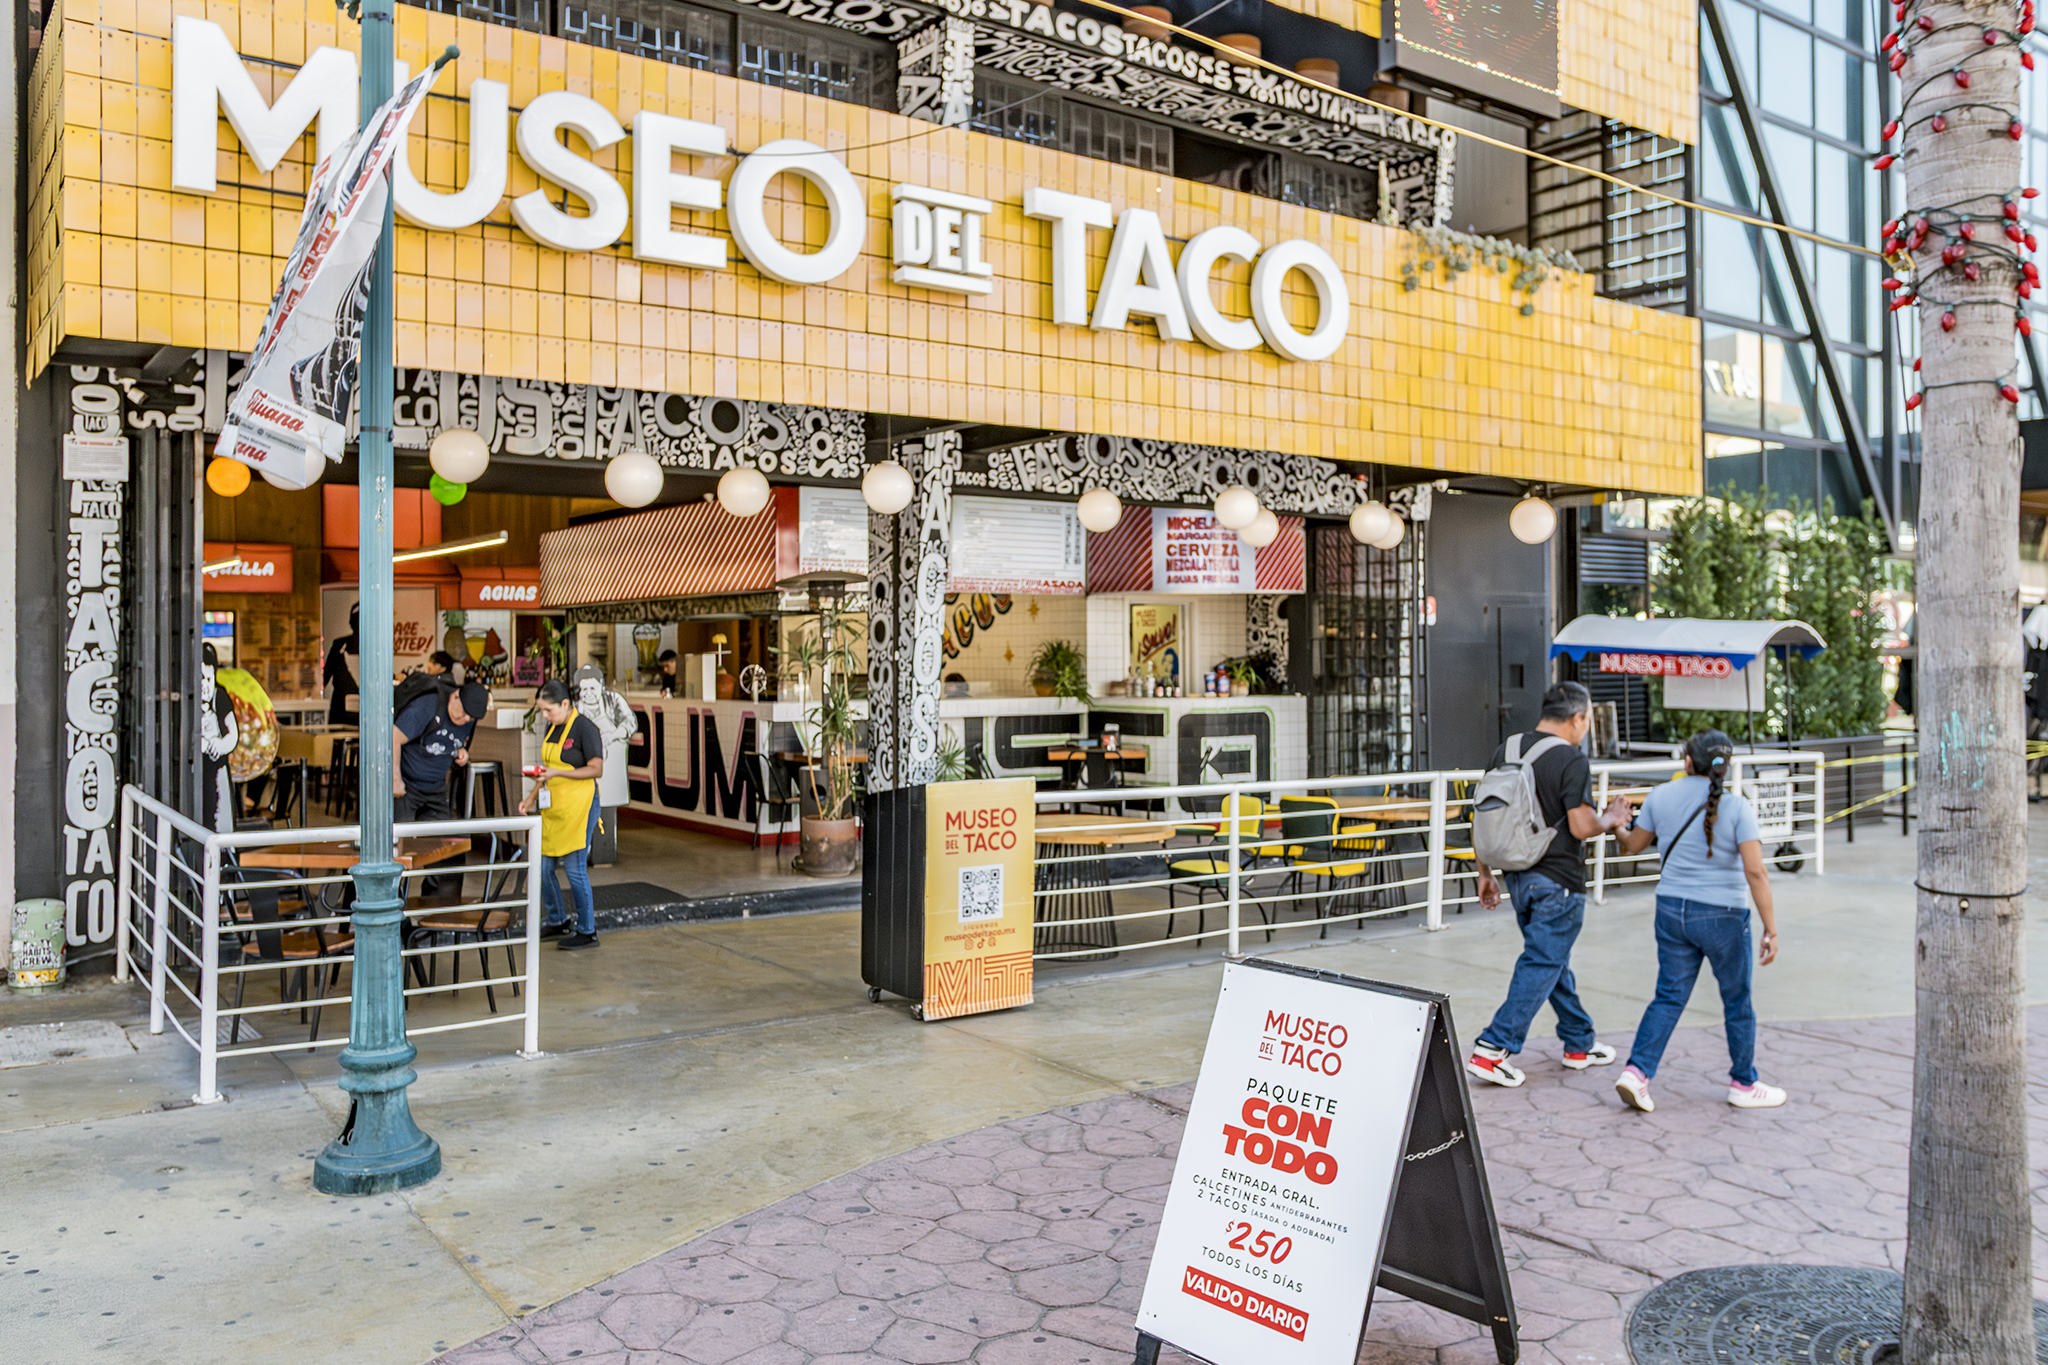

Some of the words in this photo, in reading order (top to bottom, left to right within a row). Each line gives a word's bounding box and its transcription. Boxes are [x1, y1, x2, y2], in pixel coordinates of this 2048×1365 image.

[1121, 33, 1200, 79] TACOS
[172, 15, 867, 286] MUSEO
[890, 198, 994, 280] DEL
[1023, 187, 1351, 361] TACO
[1166, 543, 1240, 557] CERVEZA
[479, 584, 538, 602] AGUAS
[1167, 575, 1199, 584] AGUAS
[1600, 652, 1664, 675] MUSEO
[1678, 655, 1732, 679] TACO
[65, 722, 119, 759] TACO
[945, 807, 1017, 831] MUSEO
[945, 839, 960, 851] DEL
[963, 830, 1017, 854] TACO
[944, 927, 1017, 943] museodeltaco.mx
[22, 957, 51, 968] CREW
[1264, 1009, 1348, 1050] MUSEO
[1259, 1041, 1275, 1056] DEL
[1280, 1040, 1342, 1077] TACO
[1246, 1077, 1338, 1116] PAQUETE
[1241, 1096, 1333, 1148] CON
[1222, 1123, 1338, 1186] TODO
[1192, 1173, 1267, 1208] CALCETINES
[1269, 1201, 1349, 1234] ANTIDERRAPANTES
[1221, 1167, 1280, 1197] ENTRADA
[1281, 1186, 1320, 1211] GRAL.
[1197, 1188, 1205, 1200] 2
[1207, 1191, 1248, 1215] TACOS
[1250, 1208, 1281, 1225] (ASADA
[1282, 1220, 1288, 1228] O
[1290, 1222, 1336, 1245] ADOBADA)
[1225, 1219, 1293, 1265] $250
[1201, 1245, 1242, 1271] TODOS
[1245, 1261, 1269, 1281] LOS
[1272, 1271, 1304, 1294] DÍAS
[1185, 1269, 1244, 1309] VALIDO
[1245, 1294, 1306, 1335] DIARIO
